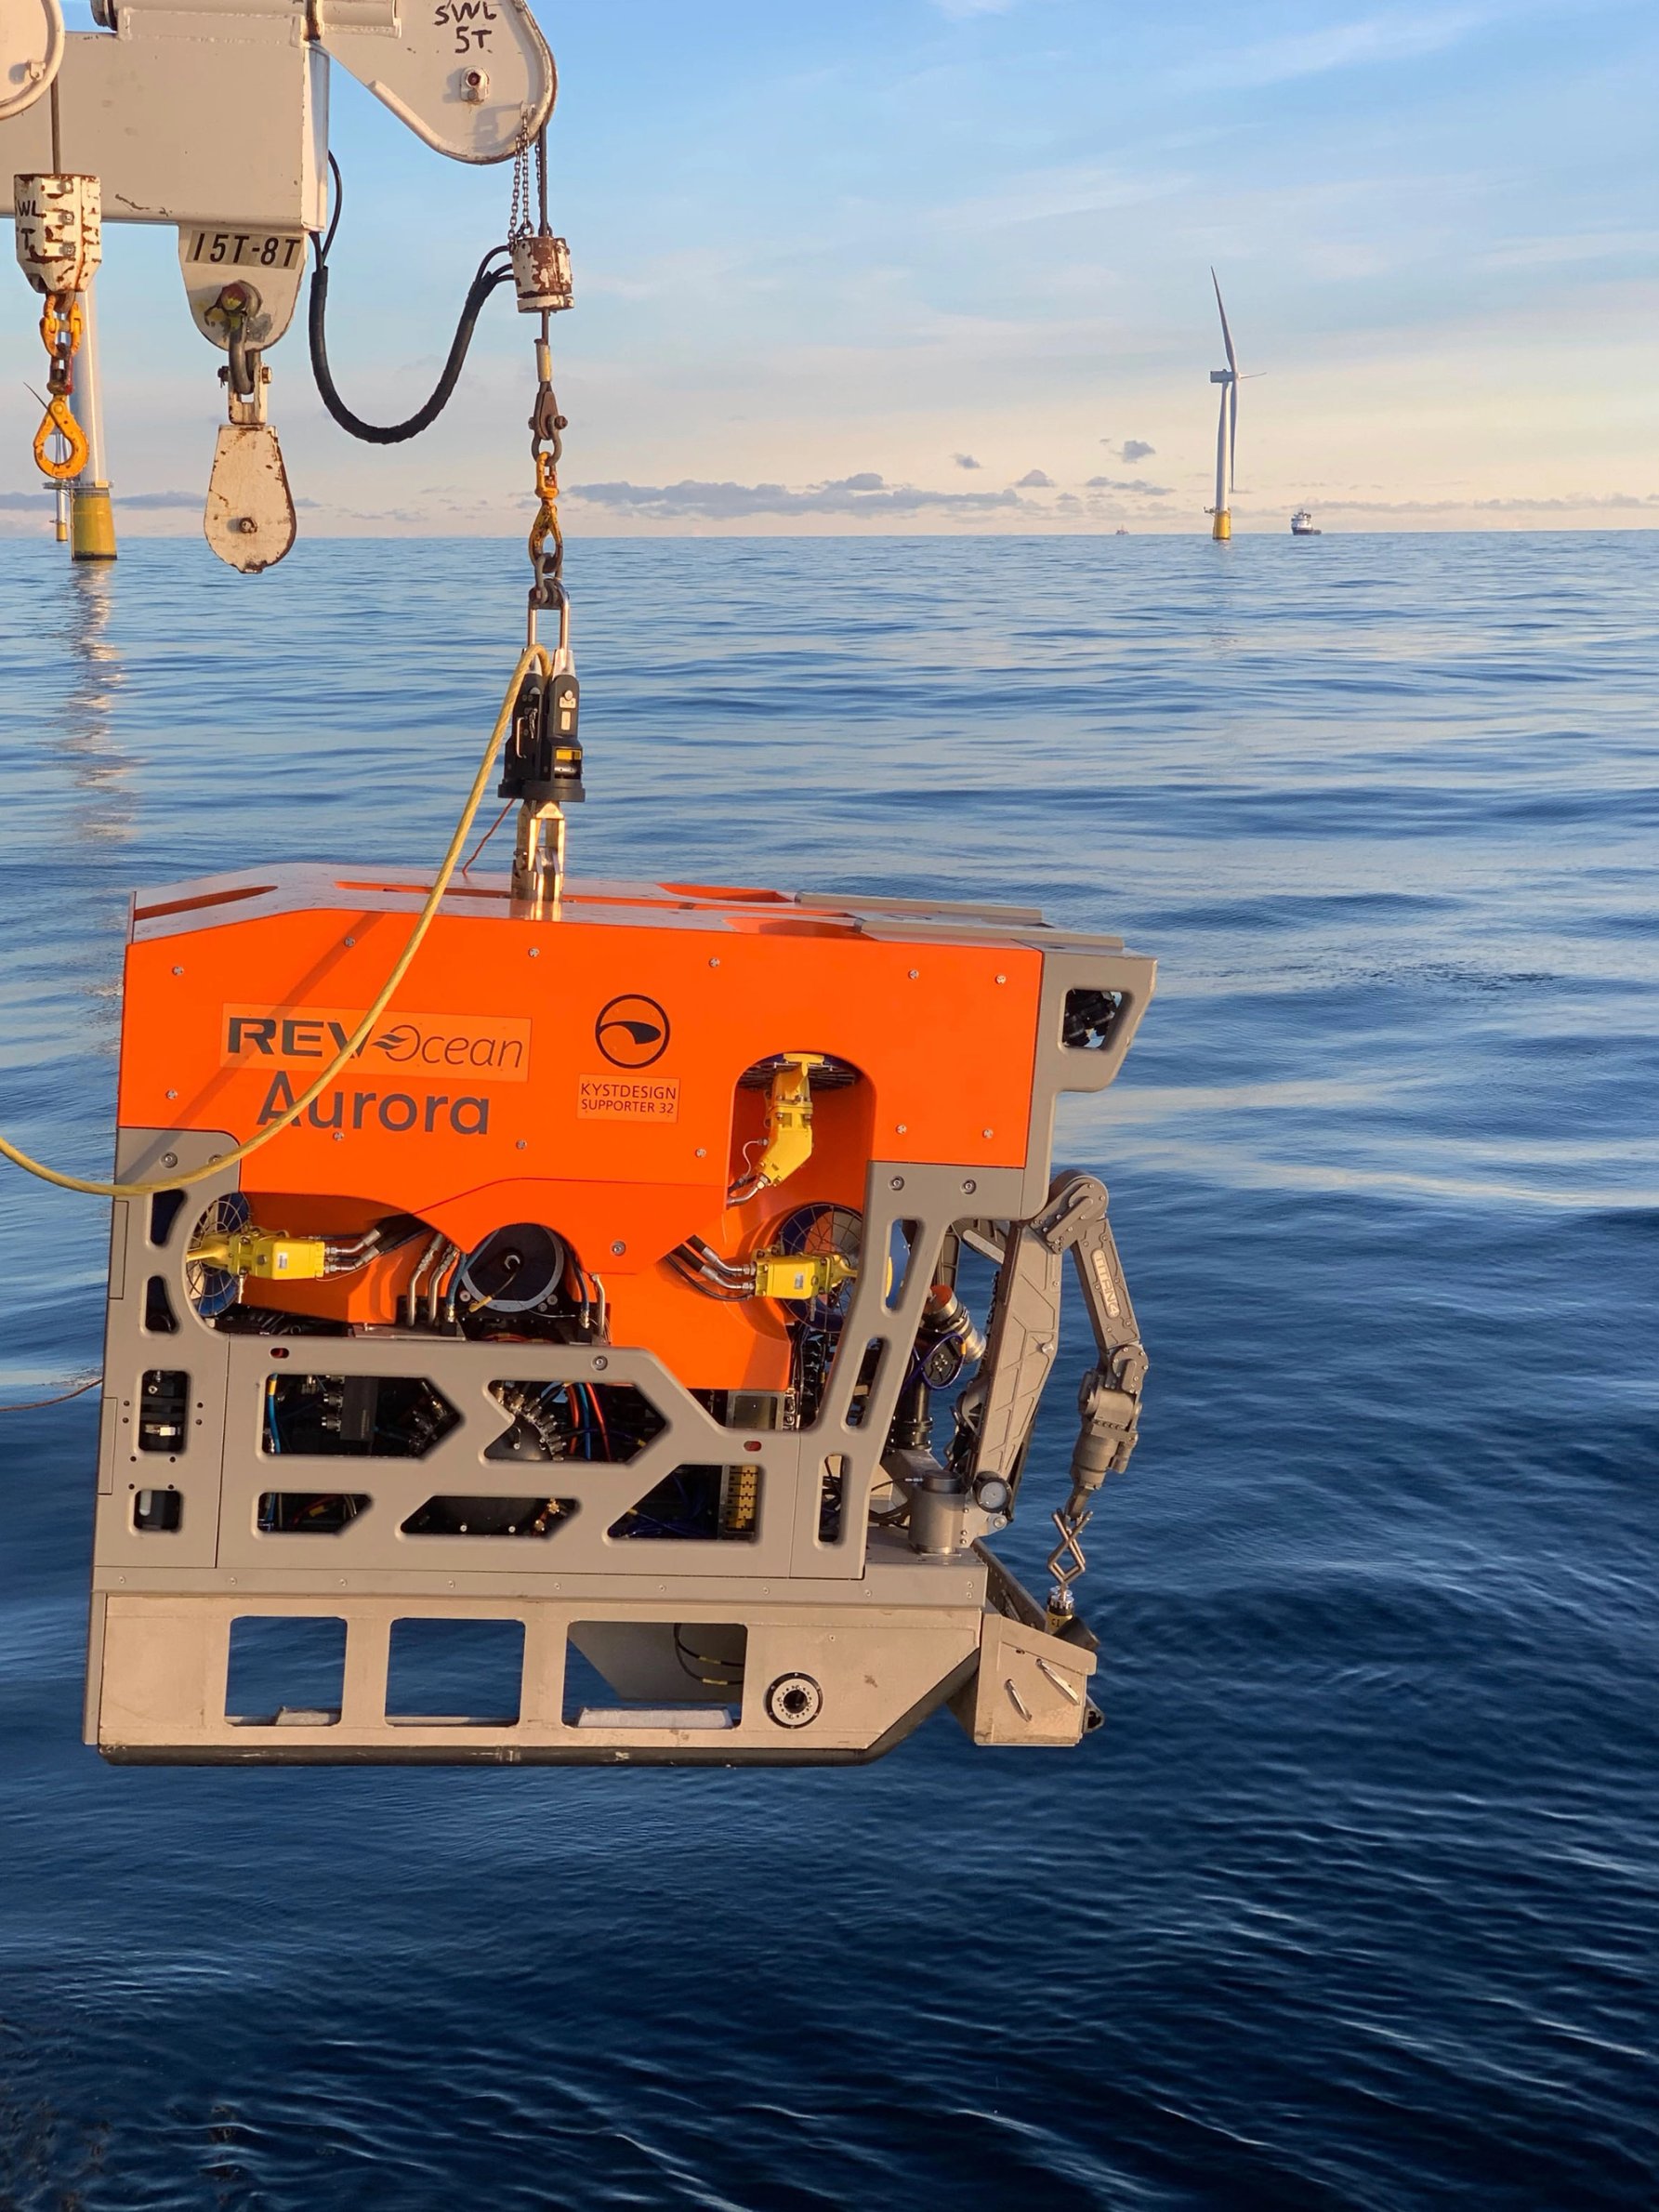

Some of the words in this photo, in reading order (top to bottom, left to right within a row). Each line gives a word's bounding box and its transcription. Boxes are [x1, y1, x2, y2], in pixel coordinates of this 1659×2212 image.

[434, 0, 497, 26] SWL
[454, 26, 493, 54] 5T
[15, 199, 46, 218] WL
[192, 232, 301, 267] 15T-8T
[372, 1024, 523, 1069] Ocean
[256, 1070, 490, 1136] Aurora
[580, 1083, 677, 1100] KYSTDESIGN
[581, 1099, 655, 1113] SUPPORTER
[658, 1102, 675, 1114] 32
